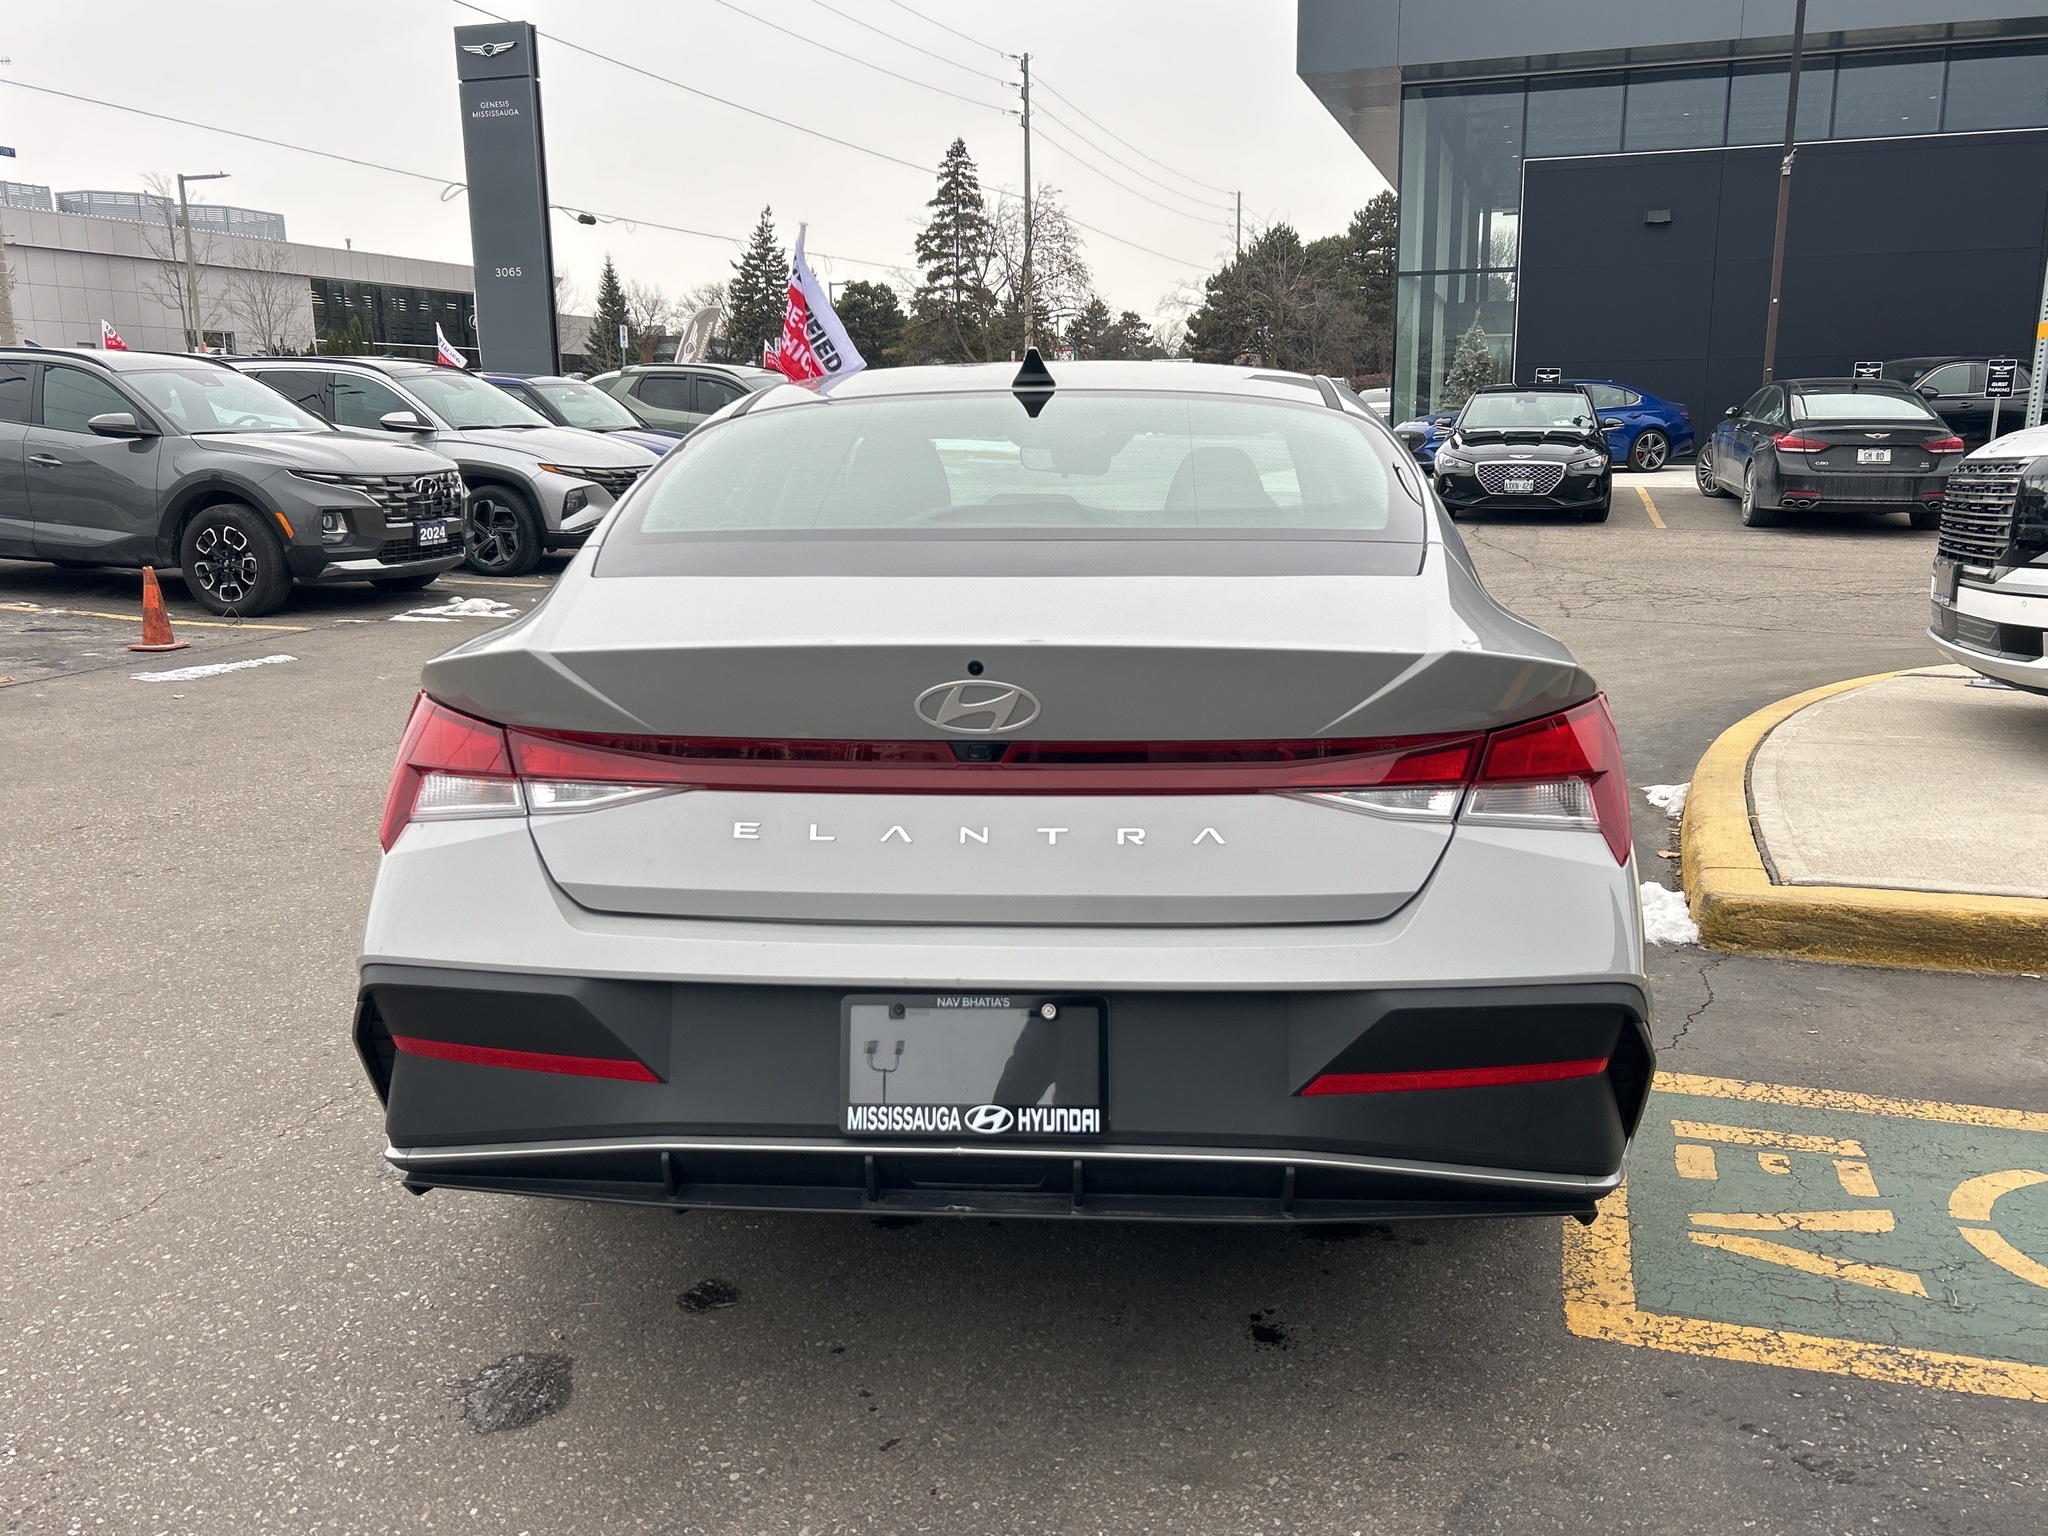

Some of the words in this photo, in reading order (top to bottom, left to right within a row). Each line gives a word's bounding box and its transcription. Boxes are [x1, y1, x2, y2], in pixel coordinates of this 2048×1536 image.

[480, 100, 510, 109] GENESIS
[472, 109, 520, 118] MISSISSAUGA
[495, 266, 522, 278] 3065
[420, 525, 446, 541] 2024
[732, 821, 1227, 846] ELANTRA
[936, 997, 961, 1008] NAV
[962, 996, 1011, 1008] BHATIA'S
[847, 1105, 962, 1131] MISSISSAUGA
[1017, 1107, 1100, 1133] HYUNDAI
